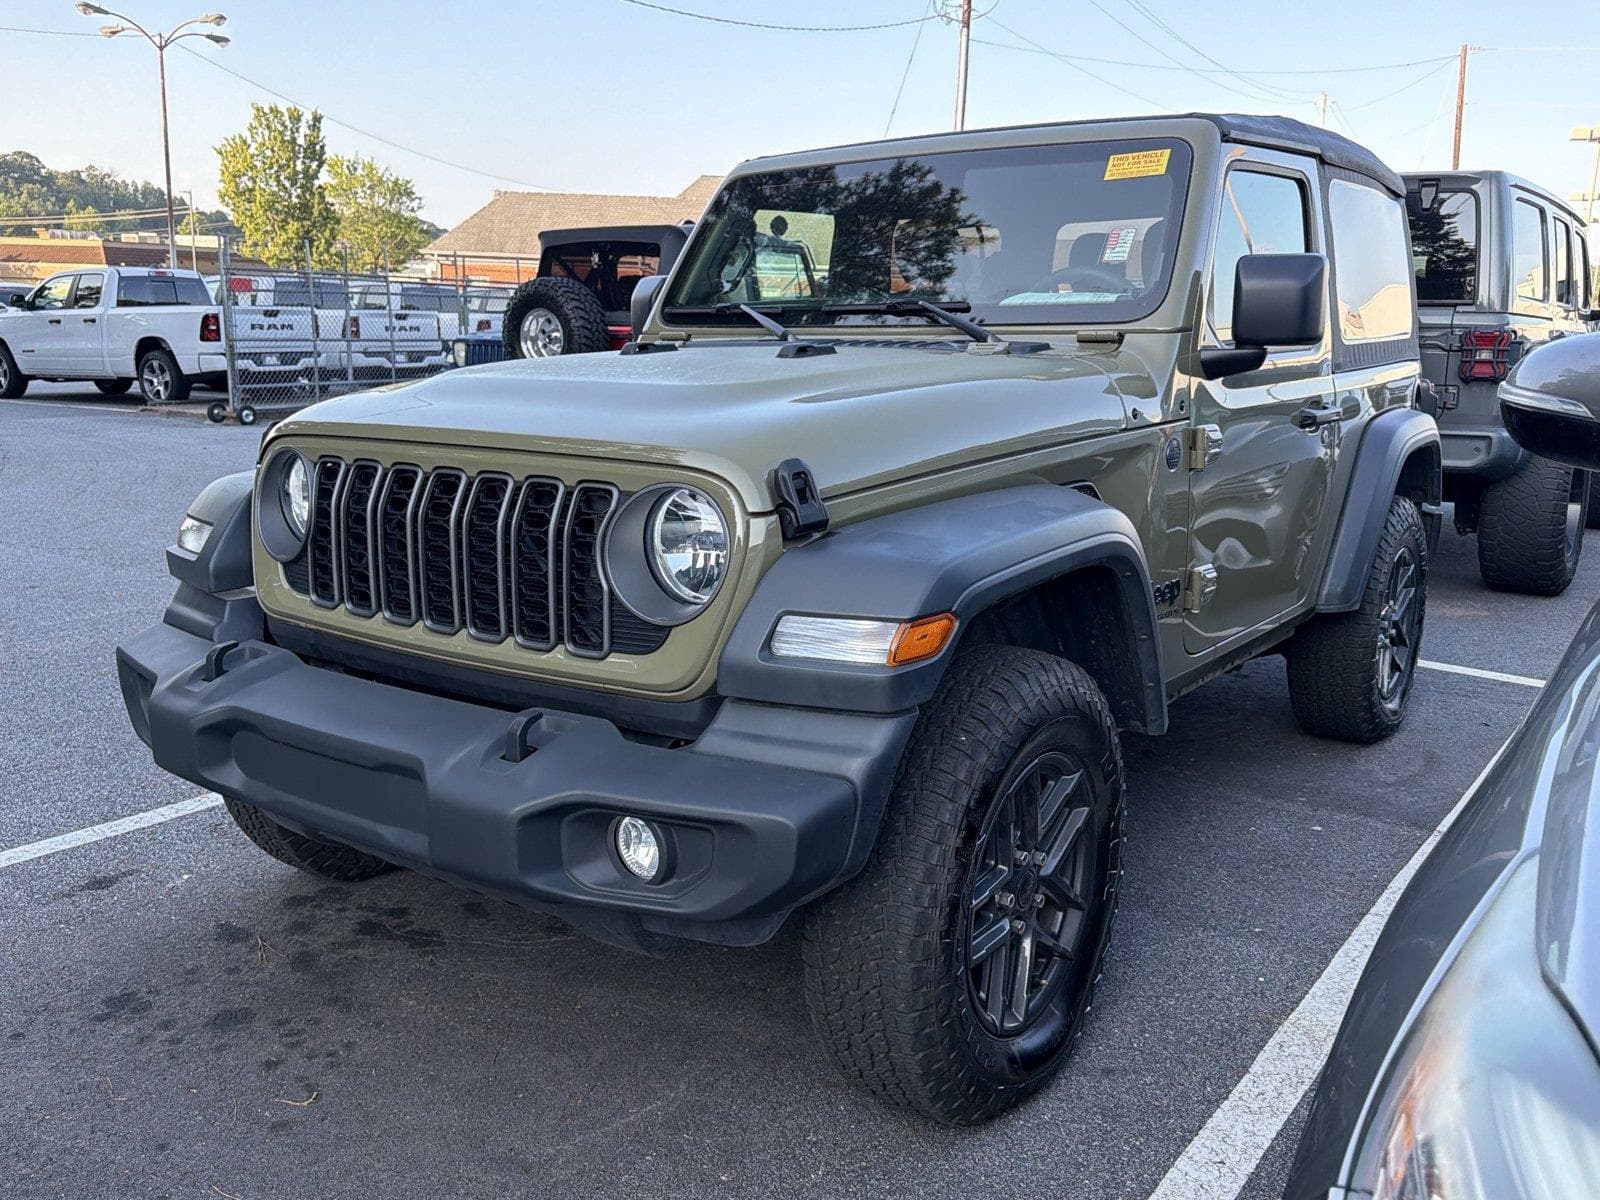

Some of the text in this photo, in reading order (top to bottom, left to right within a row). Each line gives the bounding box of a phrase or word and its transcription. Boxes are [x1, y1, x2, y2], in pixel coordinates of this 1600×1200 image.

[1132, 151, 1165, 161] VEHICLE
[250, 323, 294, 331] RAM
[384, 325, 421, 333] RAM
